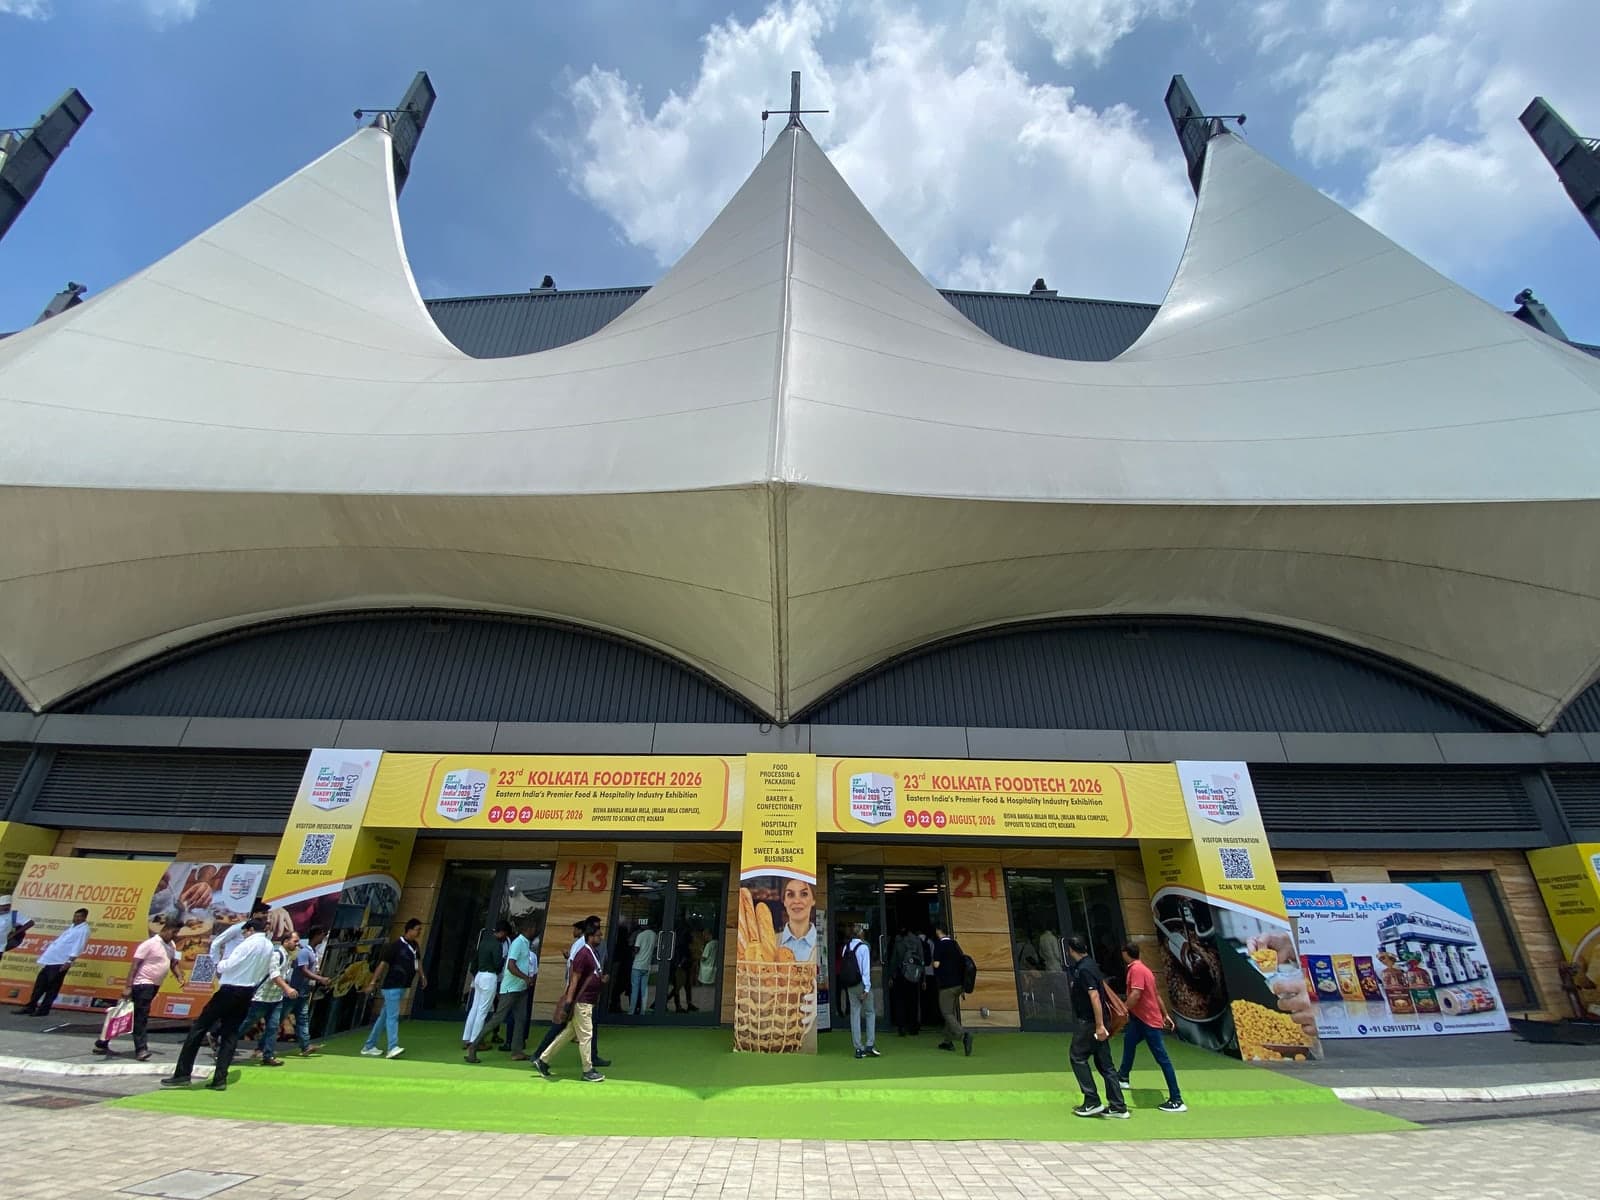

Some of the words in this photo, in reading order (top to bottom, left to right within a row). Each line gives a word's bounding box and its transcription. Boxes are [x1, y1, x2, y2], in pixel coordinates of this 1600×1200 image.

[497, 768, 524, 785] 23rd
[527, 771, 589, 786] KOLKATA
[593, 771, 666, 786] FOODTECH
[670, 772, 702, 786] 2026
[904, 773, 926, 789] 23rd
[932, 776, 991, 791] KOLKATA
[995, 777, 1066, 792] FOODTECH
[1069, 779, 1102, 793] 2026
[495, 790, 521, 798] Eastern
[522, 790, 545, 798] India's
[547, 791, 573, 799] Premier
[600, 791, 634, 800] Hospitality
[637, 791, 664, 800] Industry
[665, 791, 698, 799] Exhibition
[906, 794, 931, 802] Eastern
[932, 795, 954, 803] India's
[982, 796, 998, 804] Food
[1006, 797, 1041, 806] Hospitality
[1043, 797, 1069, 807] Industry
[1071, 798, 1103, 806] Exhibition
[534, 810, 563, 820] AUGUST,
[565, 810, 583, 820] 2026
[907, 815, 915, 823] 21
[935, 816, 944, 824] 23
[948, 815, 977, 826] AUGUST,
[979, 816, 995, 825] 2026
[28, 863, 59, 879] 23RD
[557, 862, 577, 893] 4
[587, 862, 609, 893] 3
[953, 866, 973, 898] 2
[984, 867, 998, 899] 1
[20, 882, 74, 900] KOLKATA
[75, 885, 143, 903] FOODTECH
[1350, 896, 1402, 911] PRINTERS
[103, 906, 137, 921] 2026
[1299, 912, 1315, 920] Keep
[1356, 912, 1368, 920] Safe
[101, 945, 128, 957] 2026
